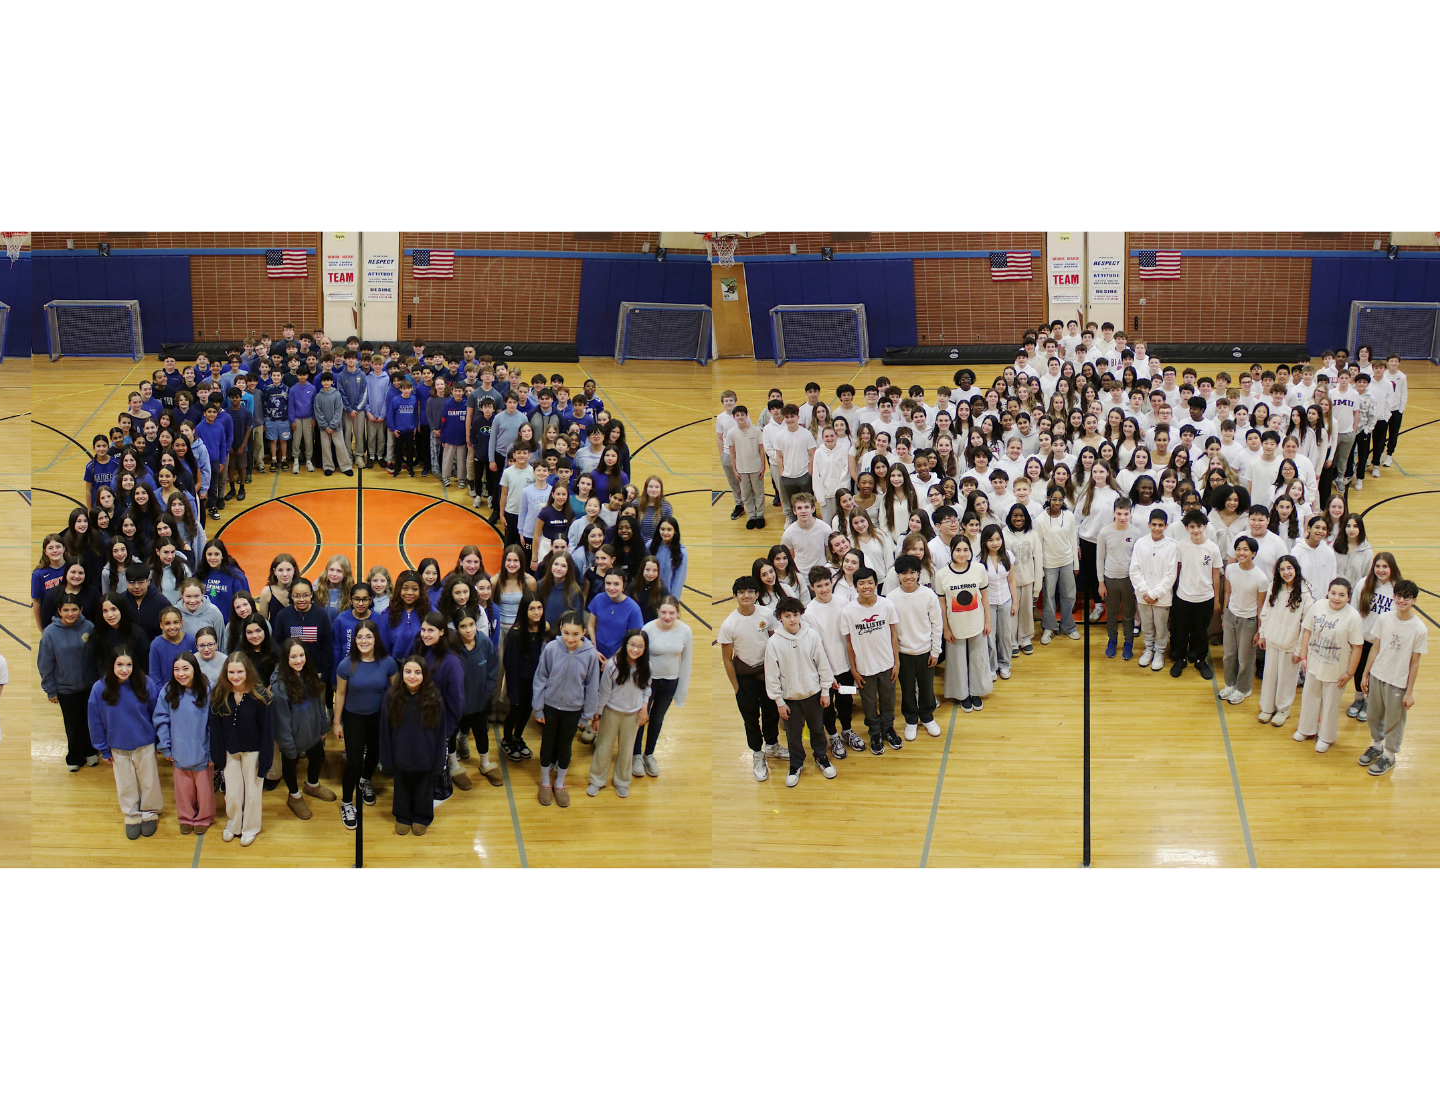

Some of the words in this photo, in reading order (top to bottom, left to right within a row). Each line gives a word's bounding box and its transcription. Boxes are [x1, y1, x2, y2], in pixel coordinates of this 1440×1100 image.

[327, 272, 354, 283] TEAM
[1052, 274, 1079, 285] TEAM
[1332, 399, 1354, 407] JMU
[93, 473, 113, 482] RAIDER
[44, 578, 60, 590] NEW
[1370, 592, 1393, 607] ENN
[854, 620, 886, 630] HOLLISTER
